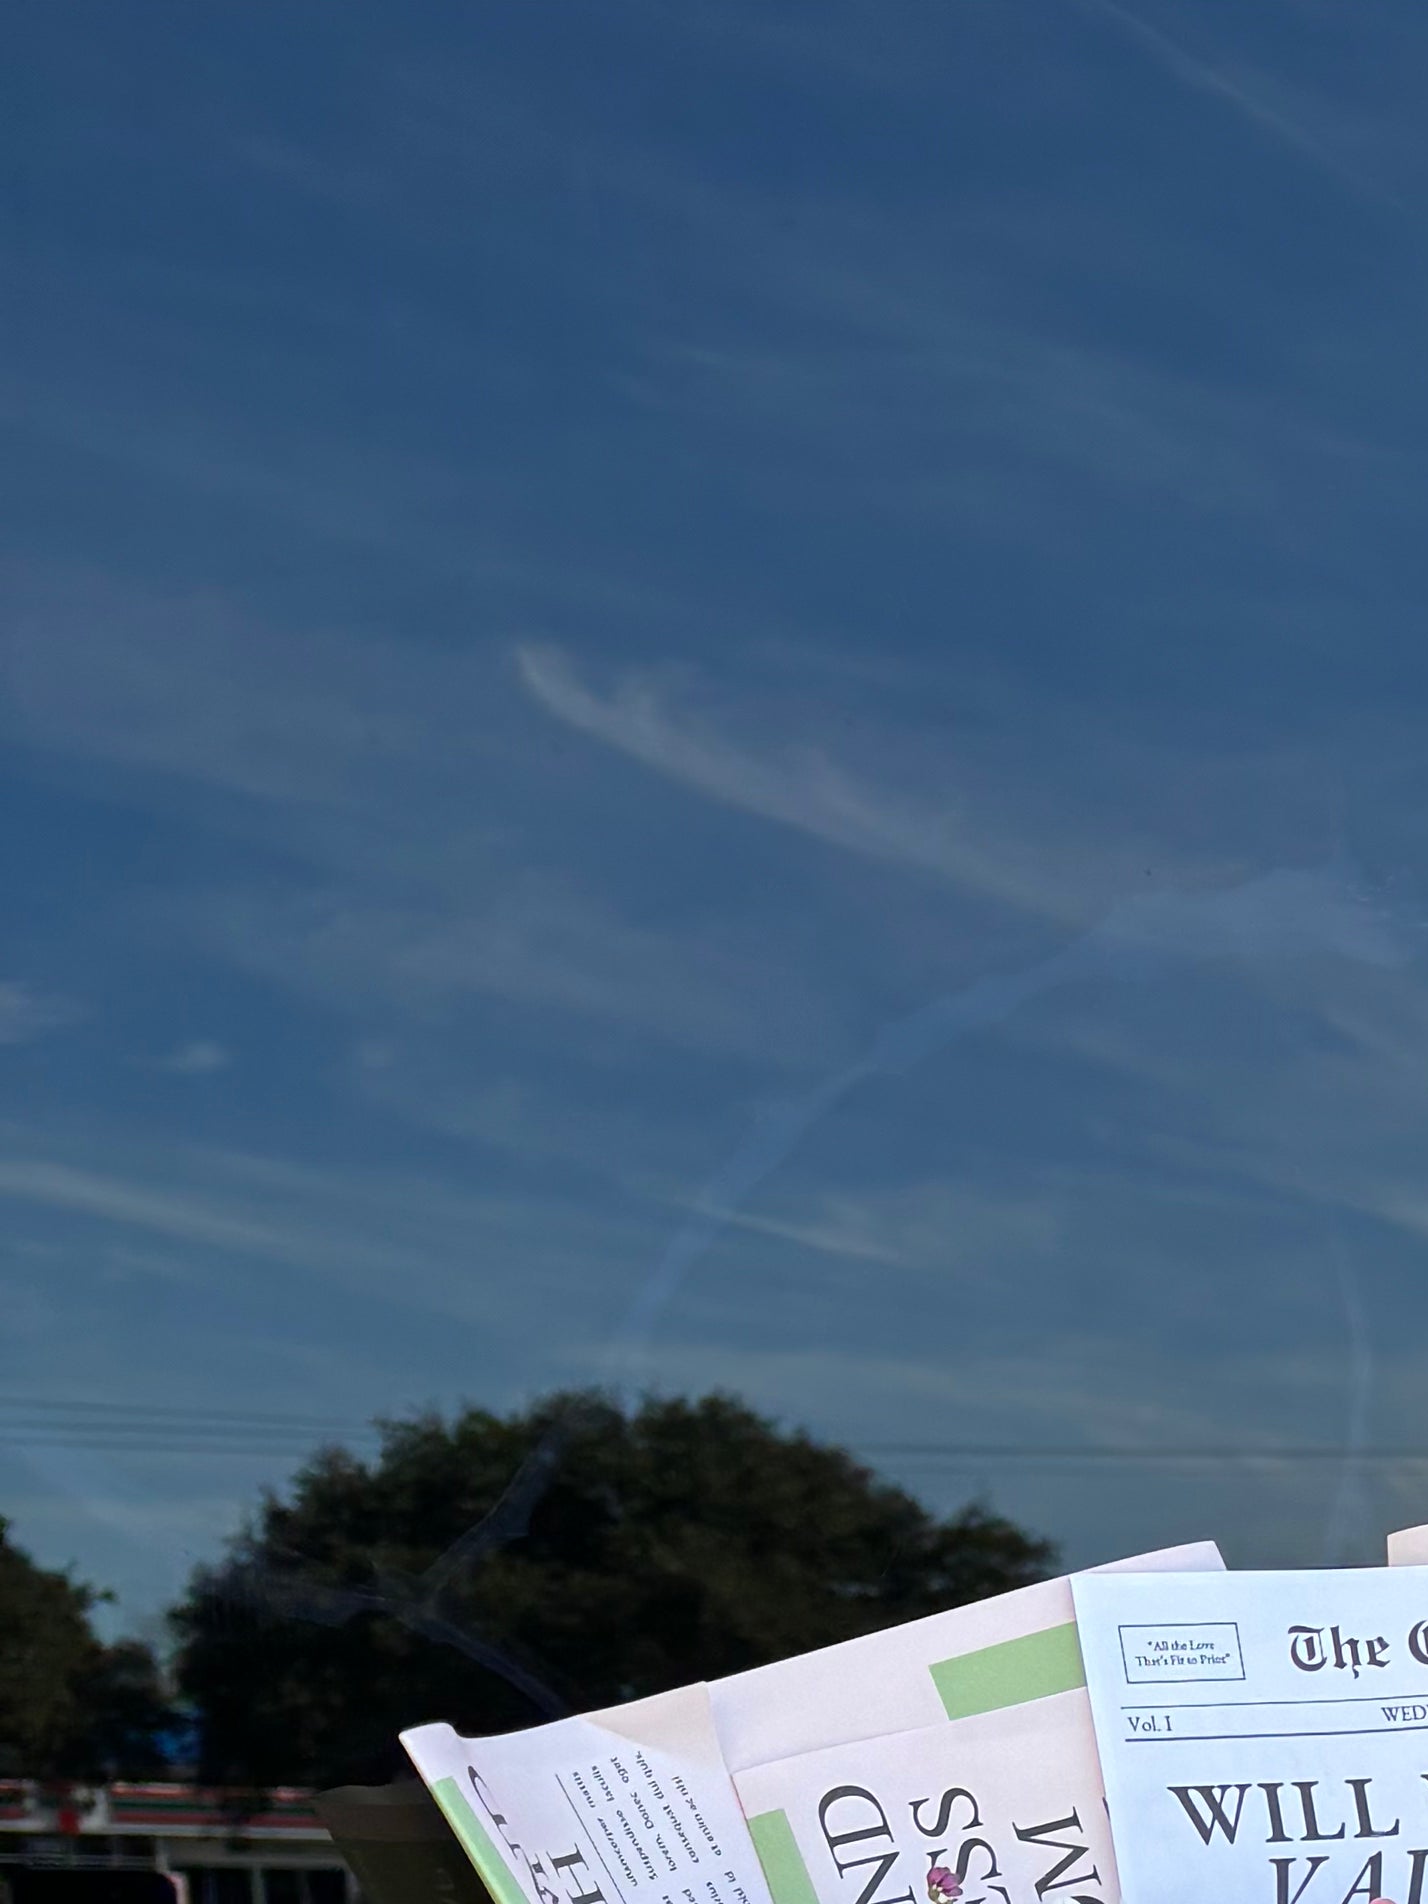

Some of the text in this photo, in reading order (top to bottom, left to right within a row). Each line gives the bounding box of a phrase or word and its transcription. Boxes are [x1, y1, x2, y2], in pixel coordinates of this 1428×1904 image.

[1287, 1616, 1391, 1685] The
[1127, 1713, 1172, 1735] Vol. I
[1167, 1777, 1400, 1846] WILL
